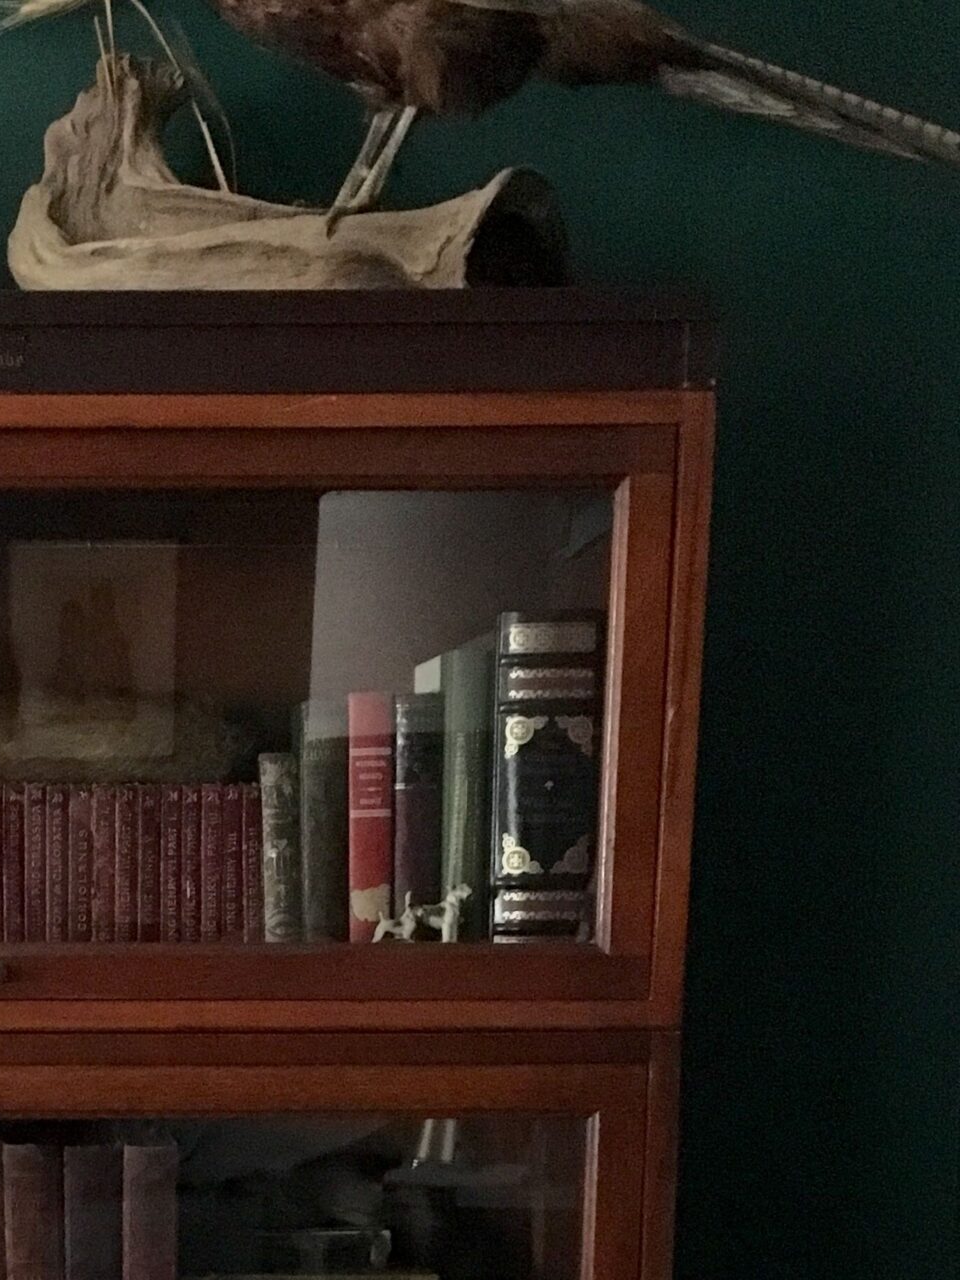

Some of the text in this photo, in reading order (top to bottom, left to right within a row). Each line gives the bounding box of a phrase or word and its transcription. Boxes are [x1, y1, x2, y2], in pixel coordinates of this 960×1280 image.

[52, 808, 62, 881] CLEOPATRA
[167, 828, 177, 856] PART
[78, 829, 88, 932] CORIOLANUS
[167, 876, 177, 916] HENRY
